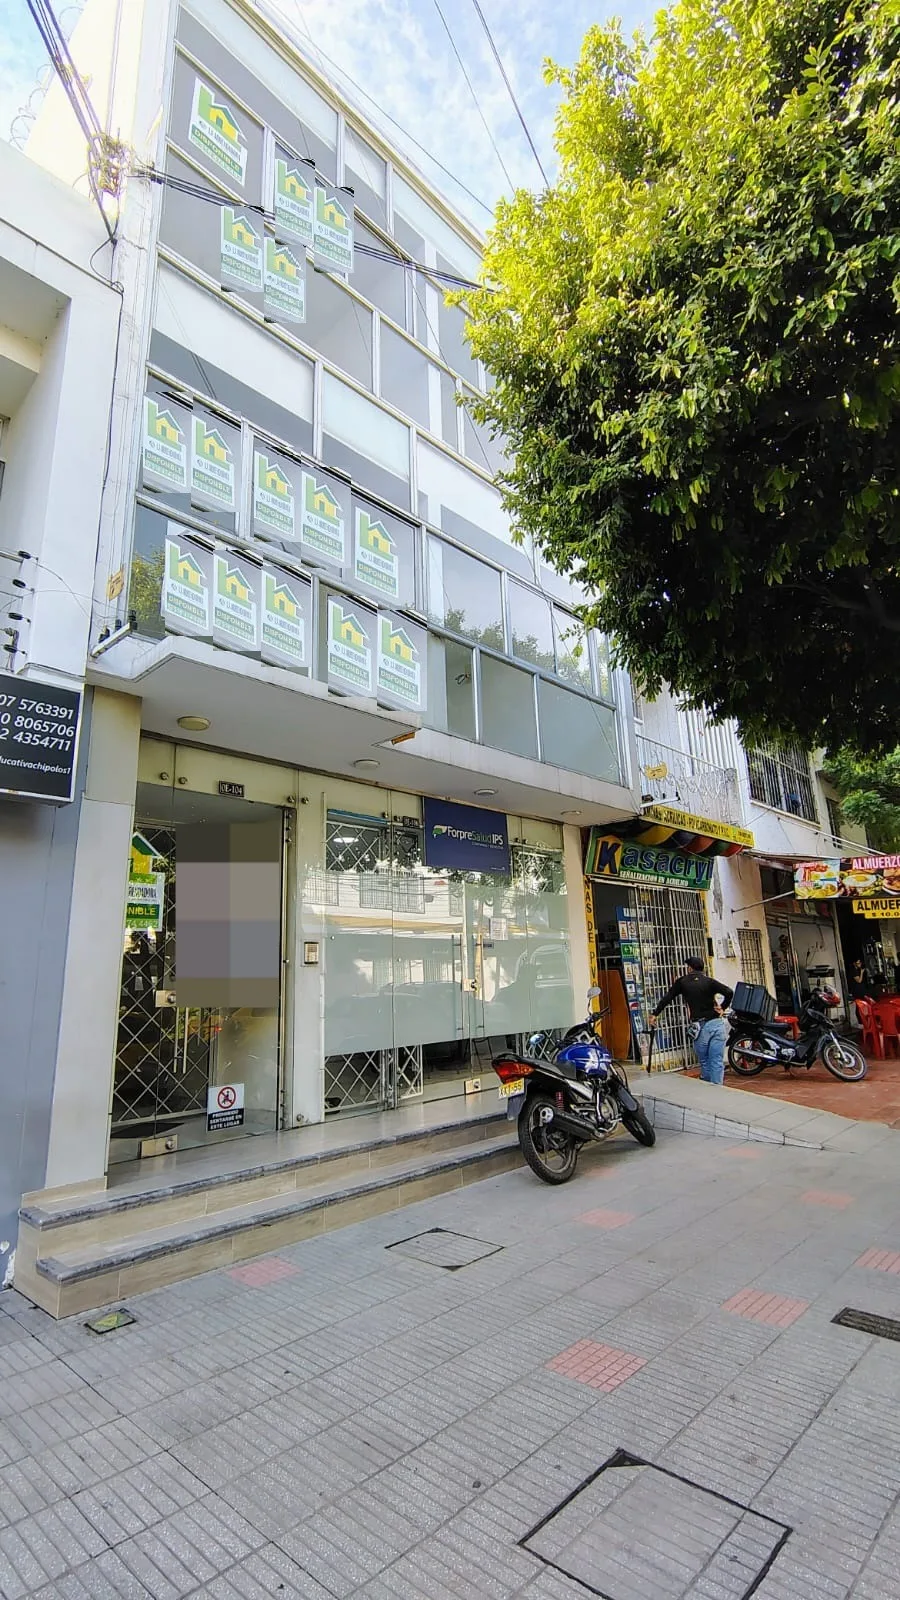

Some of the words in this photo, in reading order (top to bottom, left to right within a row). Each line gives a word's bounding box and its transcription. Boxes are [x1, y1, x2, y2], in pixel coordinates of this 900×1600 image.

[18, 698, 74, 720] 5763391
[0, 711, 11, 725] 0
[14, 715, 75, 737] 8065706
[13, 731, 71, 751] 4354711
[447, 826, 492, 842] ForpreSalud
[492, 834, 503, 845] IPS
[596, 840, 714, 885] Kasacryl
[128, 906, 156, 916] NIBLE
[587, 921, 593, 943] DE
